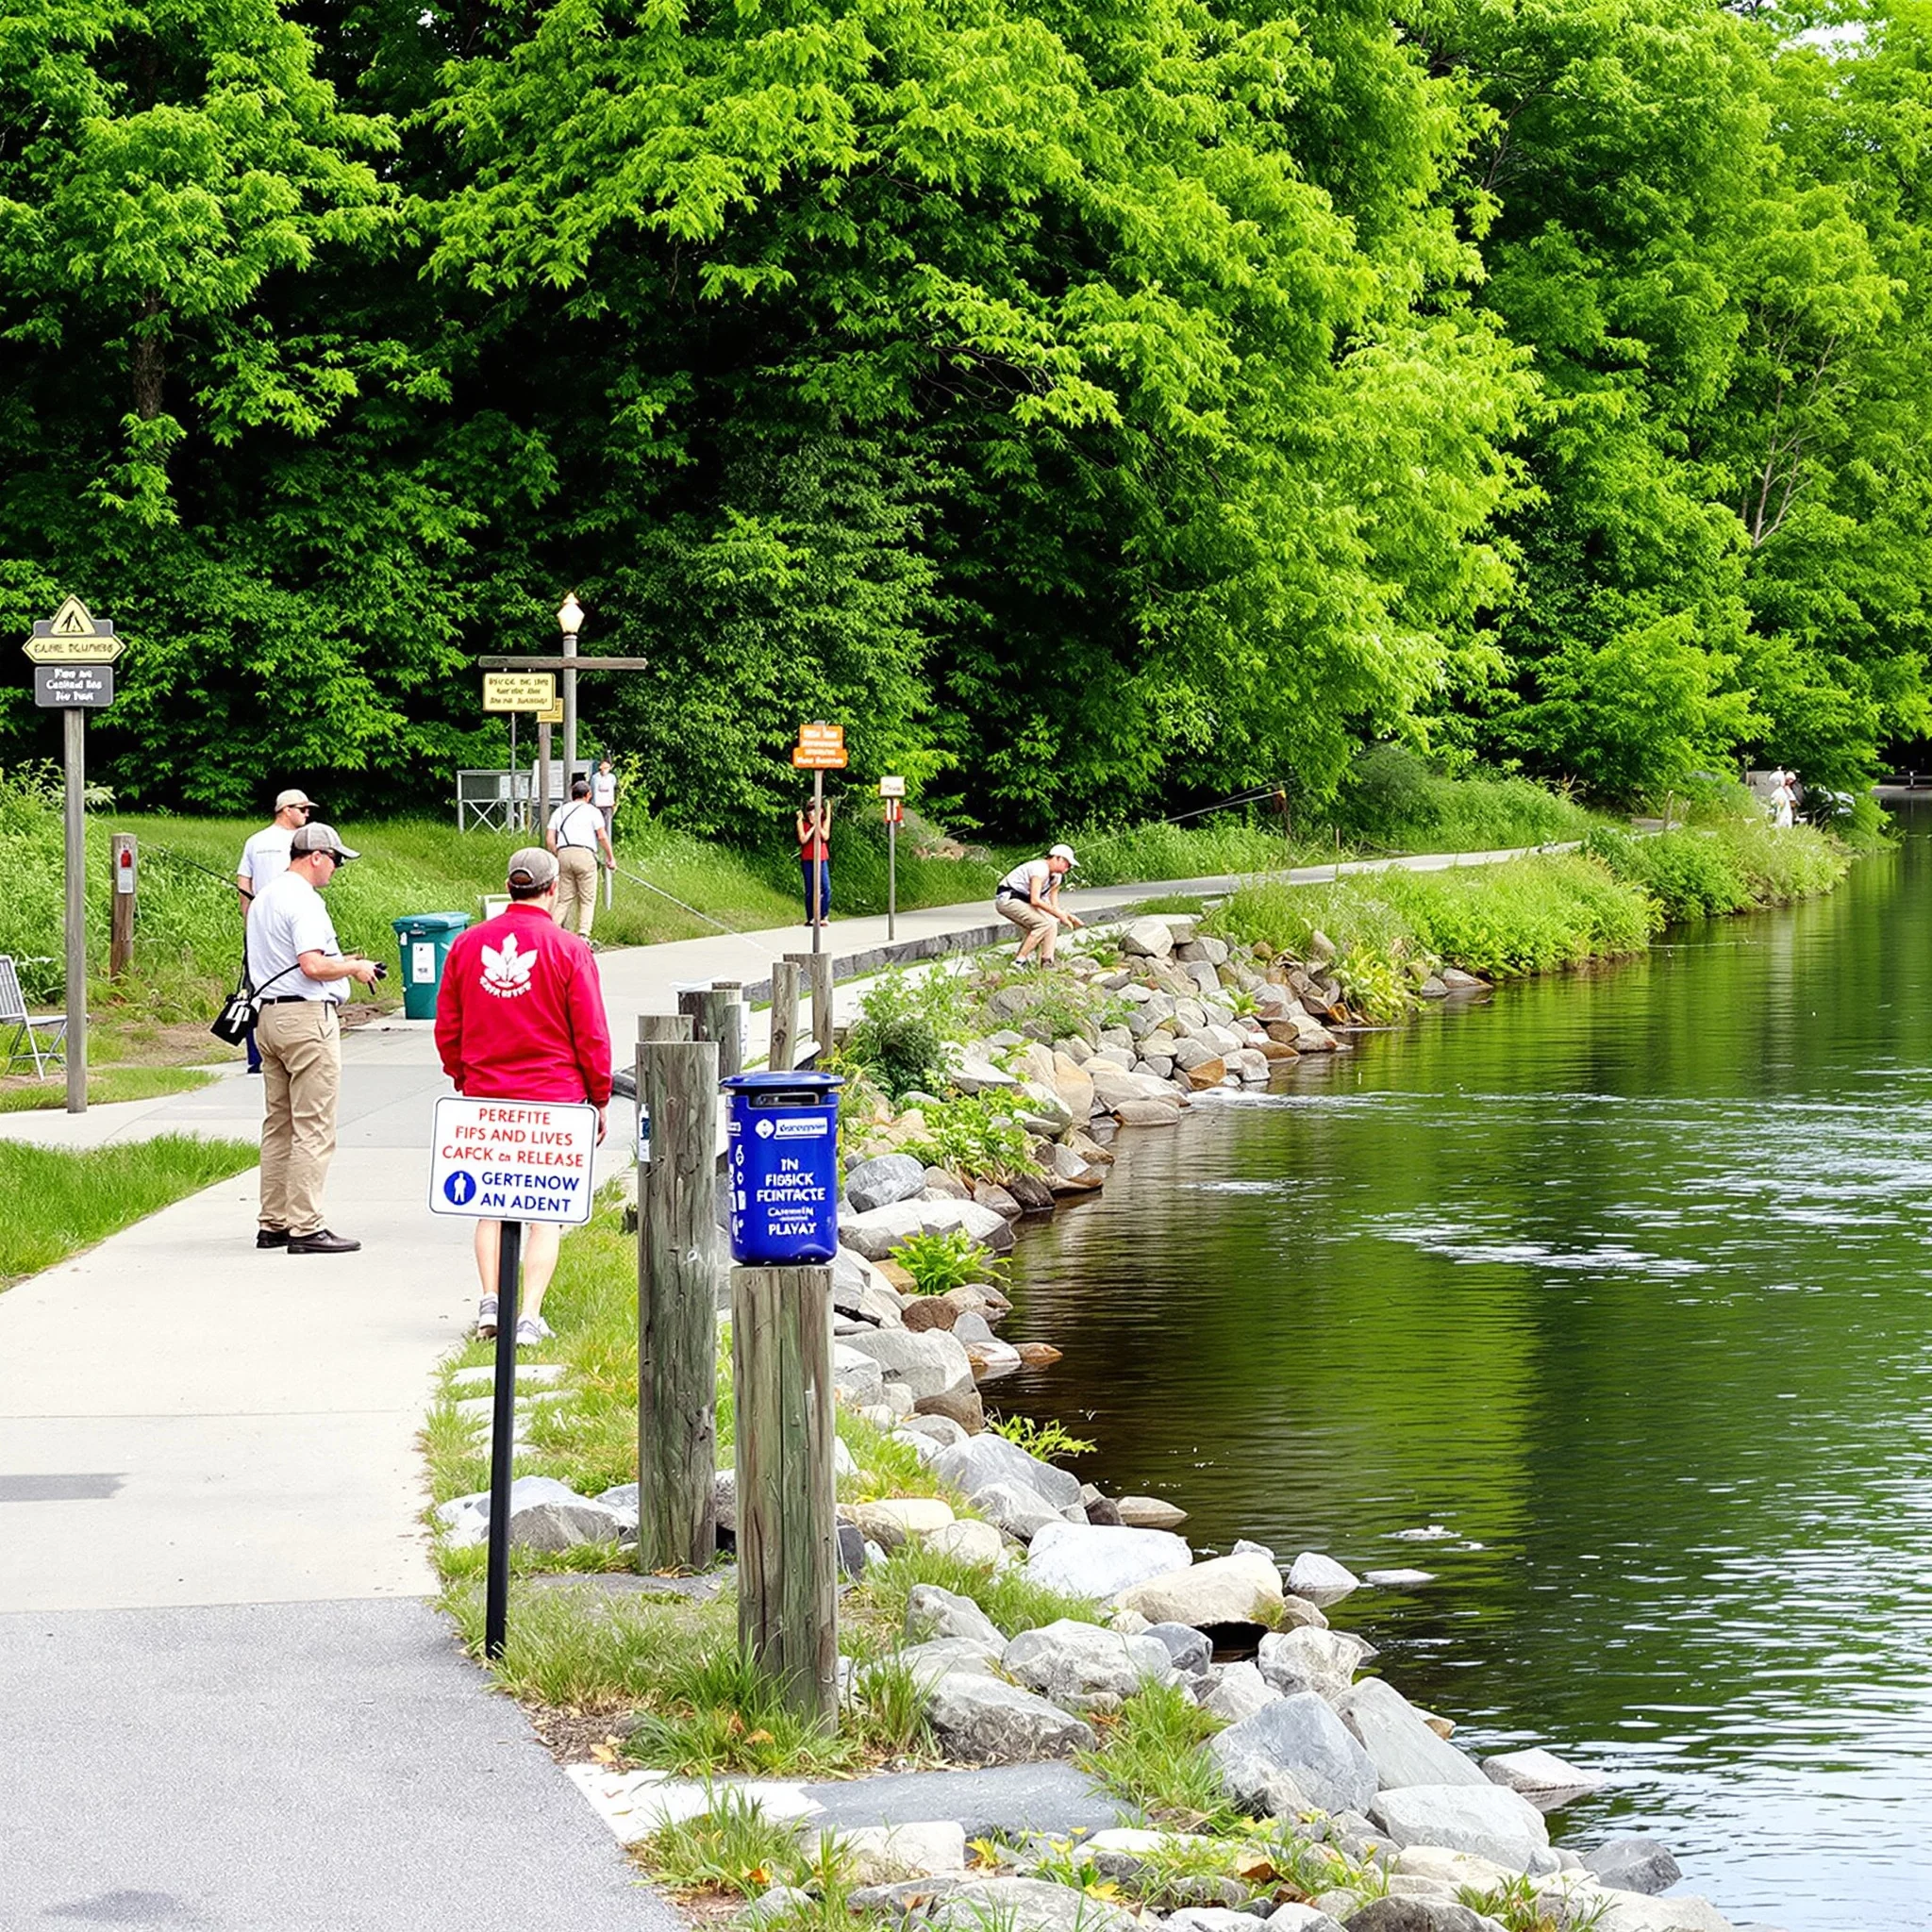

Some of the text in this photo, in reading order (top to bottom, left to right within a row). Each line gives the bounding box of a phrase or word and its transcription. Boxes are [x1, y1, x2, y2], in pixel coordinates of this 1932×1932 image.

[479, 1108, 551, 1124] PEREFITE
[490, 1129, 526, 1143] AND
[531, 1131, 573, 1146] LIVES
[442, 1145, 493, 1161] CAFCK
[517, 1151, 584, 1168] RELEASE
[780, 1158, 799, 1172] IN
[481, 1172, 580, 1191] GERTENOW
[480, 1192, 572, 1212] AN ADENT
